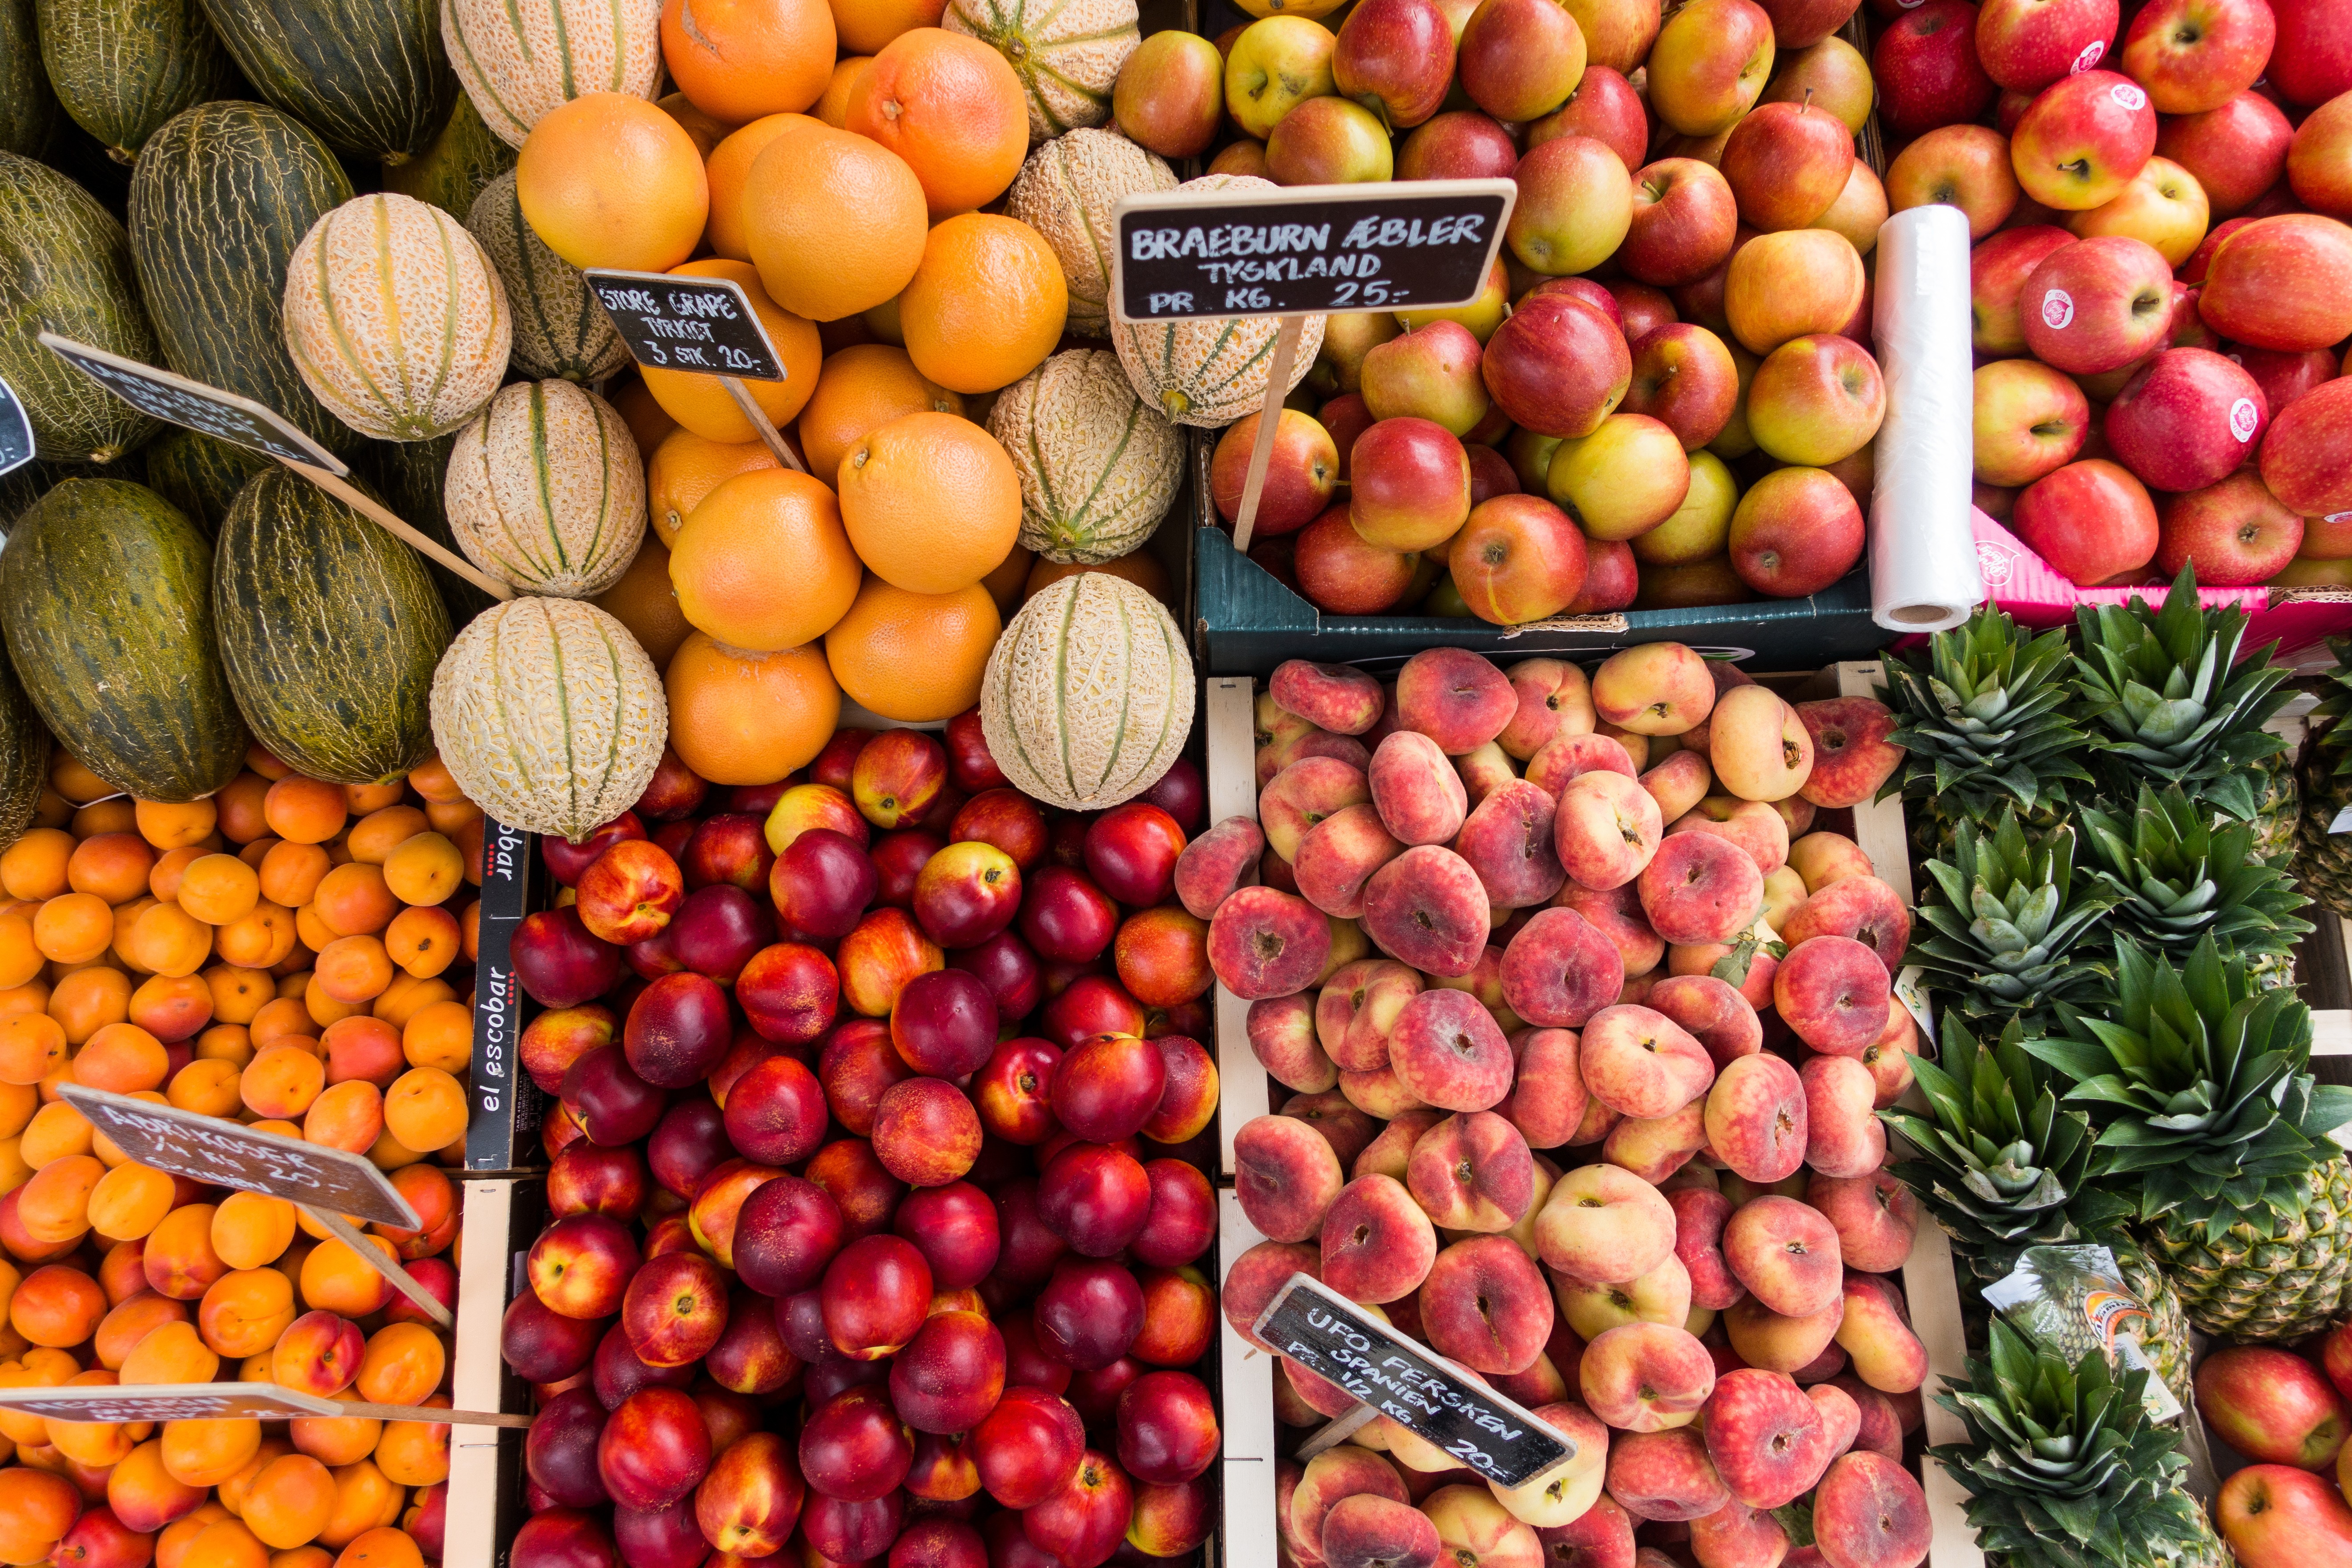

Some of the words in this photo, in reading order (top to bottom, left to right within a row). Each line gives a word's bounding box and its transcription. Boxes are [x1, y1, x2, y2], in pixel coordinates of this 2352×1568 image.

[1131, 223, 1331, 260] BRAEBURN
[1341, 214, 1485, 249] ÆBLER
[1198, 254, 1381, 284] TYSKLAND
[599, 288, 661, 315] STORE
[668, 292, 738, 319] GRAPE
[643, 340, 668, 364] 3
[675, 346, 717, 367] STK.
[480, 966, 507, 1078] escobar
[479, 1084, 500, 1112] el
[101, 1105, 323, 1173] ABRIKOSER
[1307, 1307, 1371, 1352] UFO
[1382, 1355, 1523, 1441] FERSKEN
[1330, 1349, 1442, 1415] SPANIEN
[1341, 1371, 1372, 1399] 1/2
[1380, 1399, 1417, 1428] KG.
